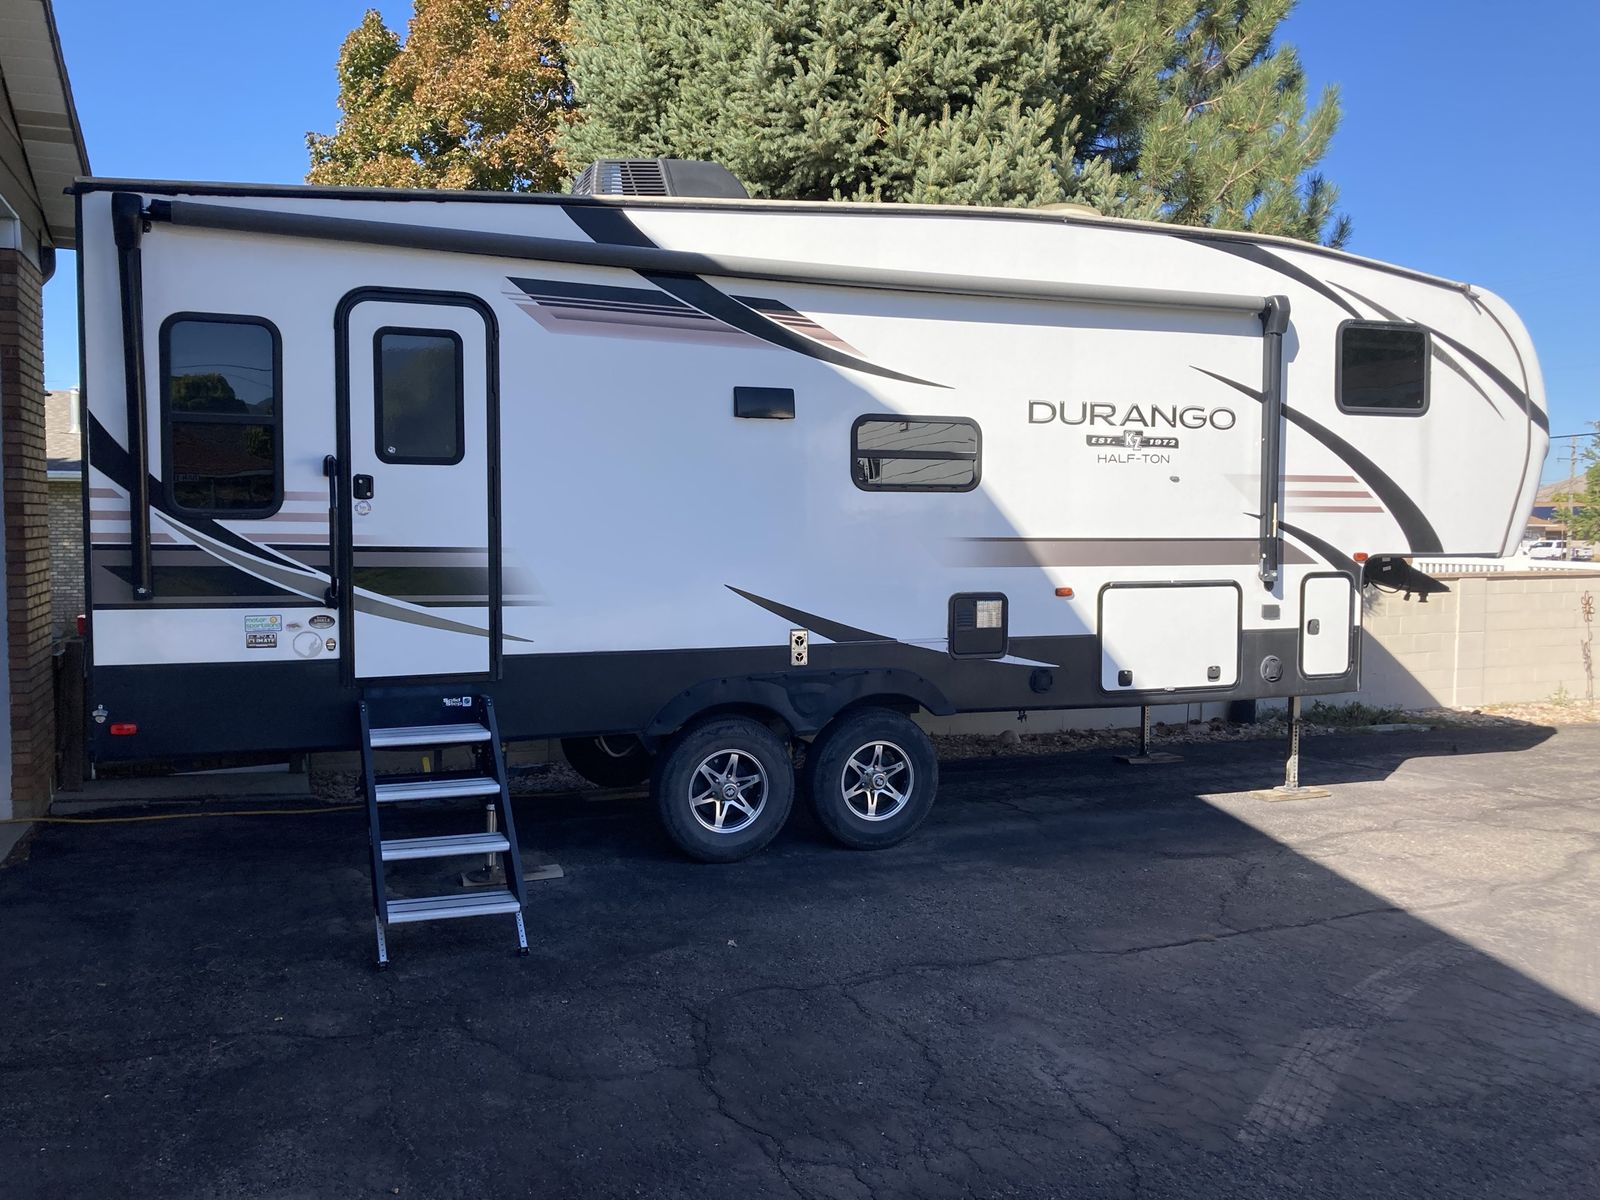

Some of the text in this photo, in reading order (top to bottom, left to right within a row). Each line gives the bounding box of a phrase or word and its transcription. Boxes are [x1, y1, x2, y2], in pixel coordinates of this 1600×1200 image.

[1028, 399, 1236, 430] DURANGO
[1124, 431, 1142, 451] KZ
[1097, 454, 1170, 464] HALF-TON
